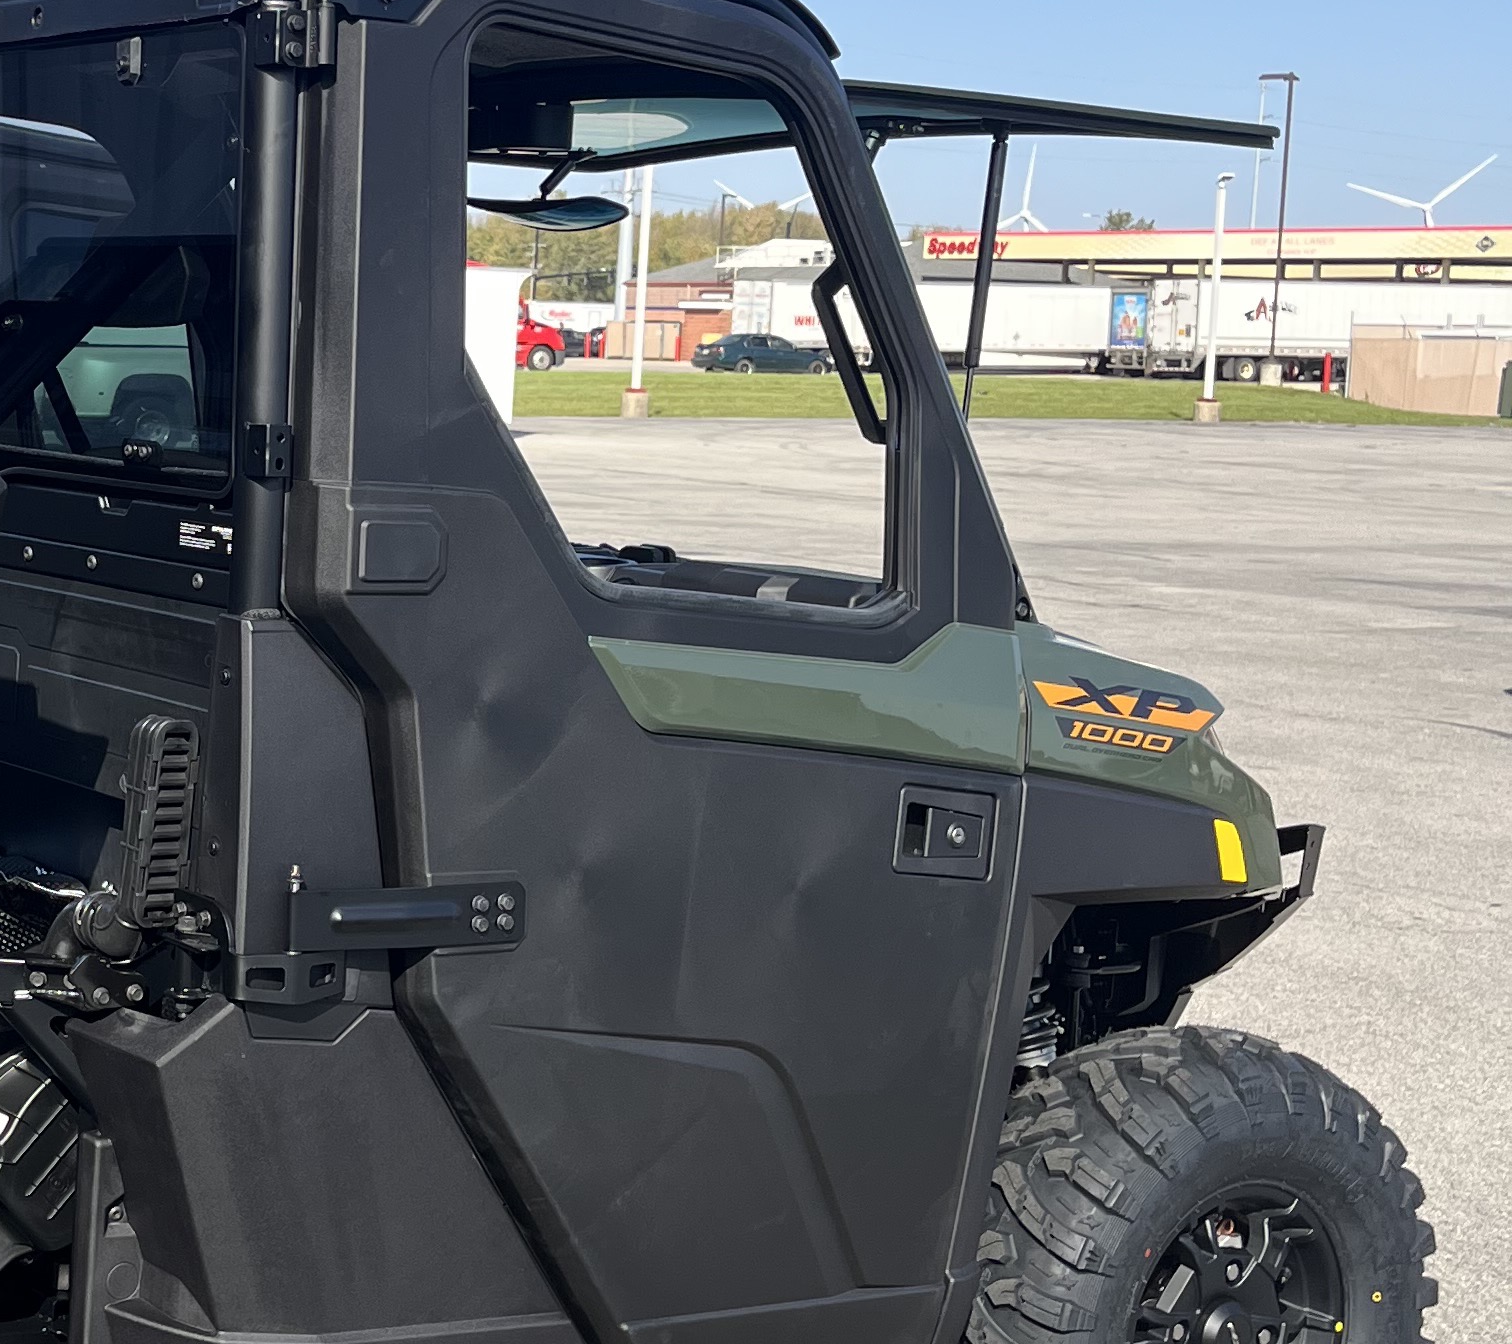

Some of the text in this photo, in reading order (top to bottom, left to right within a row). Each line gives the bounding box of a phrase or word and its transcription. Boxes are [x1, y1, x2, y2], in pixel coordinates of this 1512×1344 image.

[1053, 675, 1197, 721] XP
[1062, 742, 1089, 754] DUAL
[1069, 720, 1174, 753] 1000
